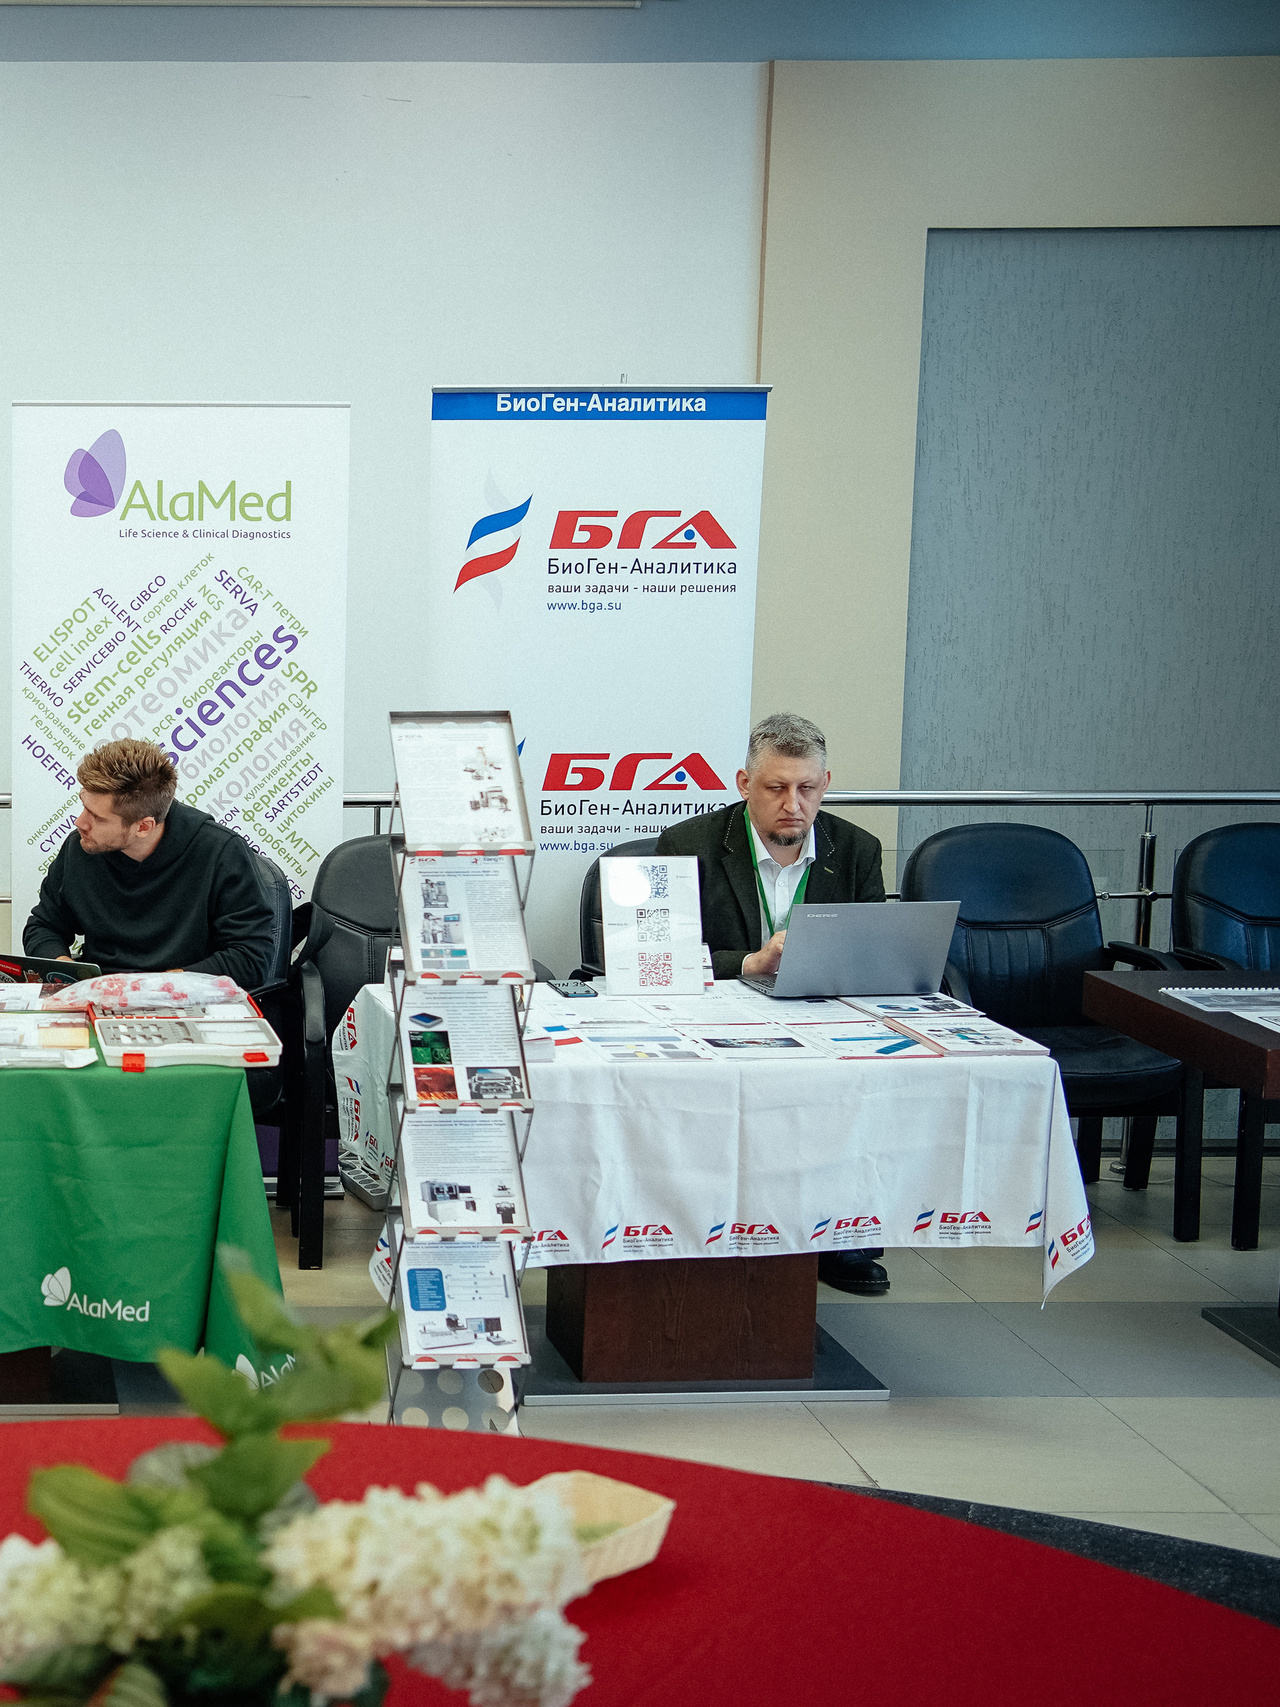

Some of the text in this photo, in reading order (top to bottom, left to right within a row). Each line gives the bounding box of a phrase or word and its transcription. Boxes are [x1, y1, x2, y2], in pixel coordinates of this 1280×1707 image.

[496, 393, 706, 413] БиоГен-Аналитика
[119, 480, 291, 522] AlaMed
[119, 529, 291, 540] Life Science & Clinical Diagnostics
[549, 510, 737, 549] БГА
[548, 557, 737, 574] БиоГен-Аналитика
[92, 588, 142, 633] AGILENT
[130, 575, 166, 611] GIBCO
[143, 553, 215, 624] сортер клеток
[197, 584, 224, 611] NGS
[214, 569, 259, 617] SERVA
[237, 566, 309, 638] CAR-T петри
[547, 600, 622, 613] www.bga.su
[548, 584, 581, 593] ваши
[584, 584, 629, 595] задачи
[642, 584, 676, 593] наши
[680, 584, 736, 595] решения
[33, 597, 96, 663] ELISPOT
[160, 597, 198, 635] ROCHE
[50, 616, 113, 679] cell index
[63, 631, 126, 694] SERVICEBIO
[182, 630, 264, 709] биореакторы
[19, 661, 64, 707] THERMO
[67, 630, 162, 725] stem-cells
[76, 608, 250, 766] отеомика
[83, 610, 212, 737] генная регуляция
[281, 661, 318, 699] SPR
[22, 686, 86, 751] криохранение
[152, 714, 176, 737] PCR
[180, 677, 287, 780] биология
[288, 693, 328, 731] СЭНГЕР
[30, 714, 77, 761] гель-док
[181, 702, 290, 808] роматография
[21, 734, 76, 791] HOEFER
[244, 731, 316, 802] культивирование
[542, 752, 728, 792] БГА
[242, 752, 315, 823] ферменты
[264, 762, 324, 823] SARTSTEDT
[277, 776, 335, 834] цитокины
[26, 791, 81, 846] онкомаркер
[39, 814, 78, 853] CYTIVA
[541, 825, 573, 834] ваши
[577, 824, 621, 836] задачи
[634, 824, 667, 833] наши
[253, 822, 308, 878] сорбенты
[540, 840, 614, 853] www.bga.su
[347, 1006, 358, 1050] БГА
[623, 1224, 673, 1237] БГА
[730, 1223, 780, 1235] БГА
[834, 1215, 882, 1230] БГА
[939, 1211, 991, 1224] БГА
[66, 1292, 150, 1323] AlaMed
